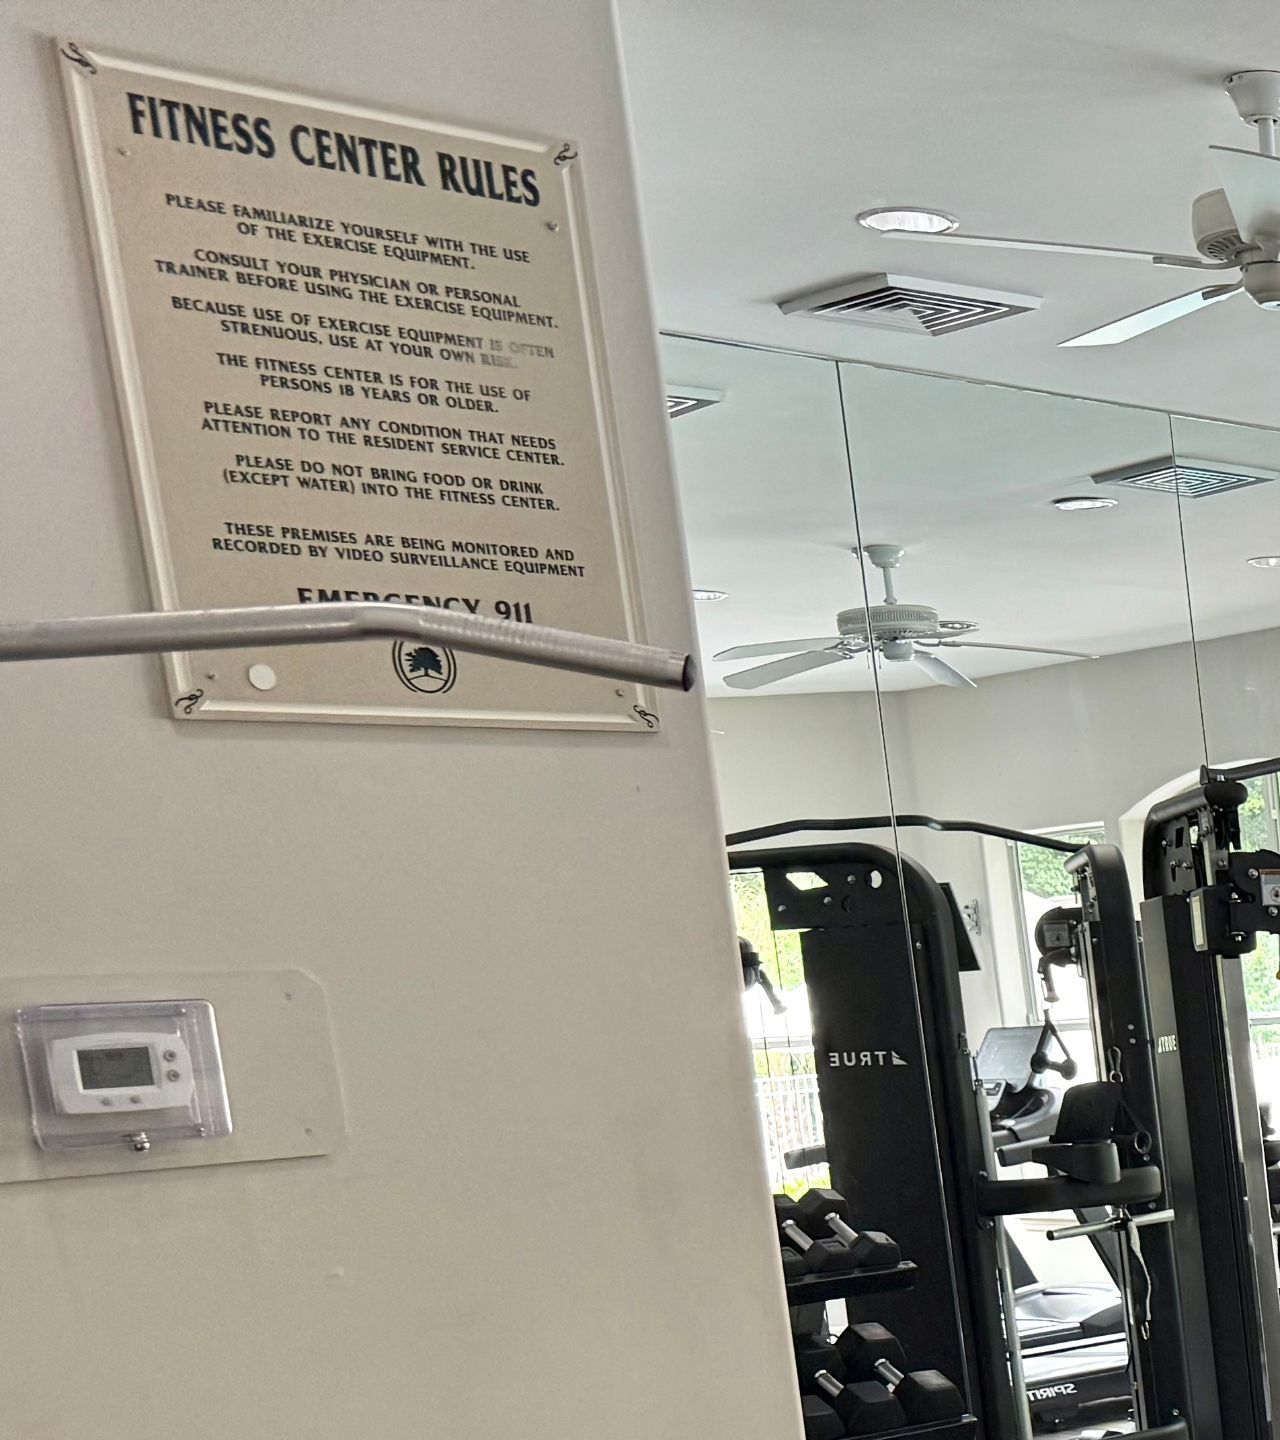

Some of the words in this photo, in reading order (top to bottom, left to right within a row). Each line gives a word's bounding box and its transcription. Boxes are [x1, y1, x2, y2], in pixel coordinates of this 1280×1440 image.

[125, 91, 276, 159] FITNESS
[289, 124, 427, 187] CENTER
[436, 151, 540, 208] RULES
[164, 192, 227, 215] PLEASE
[232, 203, 335, 233] FAMILIARIZE
[339, 221, 419, 246] YOURSELF
[423, 234, 465, 253] WITH
[468, 242, 499, 258] THE
[502, 247, 531, 264] USE
[236, 221, 259, 237] OF
[264, 225, 297, 243] THE
[301, 231, 378, 256] EXERCISE
[383, 244, 476, 270] EQUIPMENT.
[153, 259, 230, 283] TRAINER
[235, 270, 299, 293] BEFORE
[303, 281, 354, 300] USING
[357, 288, 389, 306] THE
[393, 294, 466, 316] EXERCISE
[470, 304, 559, 329] EQUIPMENT.
[193, 248, 270, 272] CONSULT
[275, 260, 324, 280] YOUR
[328, 268, 411, 293] PHYSICIAN
[416, 281, 440, 297] OR
[444, 285, 521, 308] PERSONAL
[170, 295, 248, 318] BECAUSE
[252, 306, 285, 323] USE
[290, 312, 312, 327] OF
[317, 315, 393, 338] EXERCISE
[397, 326, 484, 350] EQUIPMENT
[328, 333, 359, 349] USE
[364, 338, 384, 353] AT
[388, 340, 435, 360] YOUR
[439, 348, 476, 365] OWN
[215, 351, 249, 369] THE
[254, 356, 318, 377] FITNESS
[323, 365, 384, 385] CENTER
[389, 373, 404, 387] IS
[408, 375, 440, 391] FOR
[444, 379, 475, 395] THE
[478, 384, 508, 399] USE
[512, 388, 531, 402] OF
[259, 373, 333, 394] PERSONS
[338, 383, 355, 397] 18
[360, 385, 412, 404] YEARS
[416, 392, 440, 407] OR
[444, 395, 499, 413] OLDER.
[200, 417, 292, 439] ATTENTION
[296, 427, 321, 442] TO
[325, 430, 357, 446] THE
[362, 434, 435, 454] RESIDENT
[440, 442, 501, 460] SERVICE
[505, 449, 565, 466] CENTER.
[203, 400, 265, 420] PLEASE
[269, 407, 332, 427] REPORT
[339, 416, 371, 431] ANY
[377, 420, 463, 441] CONDITION
[467, 429, 505, 445] THAT
[510, 434, 557, 451] NEEDS
[222, 468, 290, 488] (EXCEPT
[295, 475, 356, 496] WATER)
[360, 481, 399, 498] INTO
[403, 485, 434, 501] THE
[438, 488, 496, 506] FITNESS
[501, 494, 561, 511] CENTER.
[234, 453, 295, 472] PLEASE
[299, 459, 326, 475] DO
[331, 463, 364, 479] NOT
[370, 466, 418, 484] BRING
[422, 472, 466, 487] FOOD
[471, 476, 494, 490] OR
[498, 478, 544, 495] DRINK
[211, 537, 302, 556] RECORDED
[307, 544, 329, 558] BY
[333, 546, 384, 563] VIDEO
[389, 551, 500, 571] SURVEILLANCE
[503, 559, 585, 578] EQUIPMENT
[223, 521, 275, 538] THESE
[280, 526, 358, 545] PREMISES
[364, 533, 395, 548] ARE
[400, 536, 446, 552] BEING
[451, 540, 539, 559] MONITORED
[544, 547, 575, 562] AND
[495, 600, 534, 625] 911
